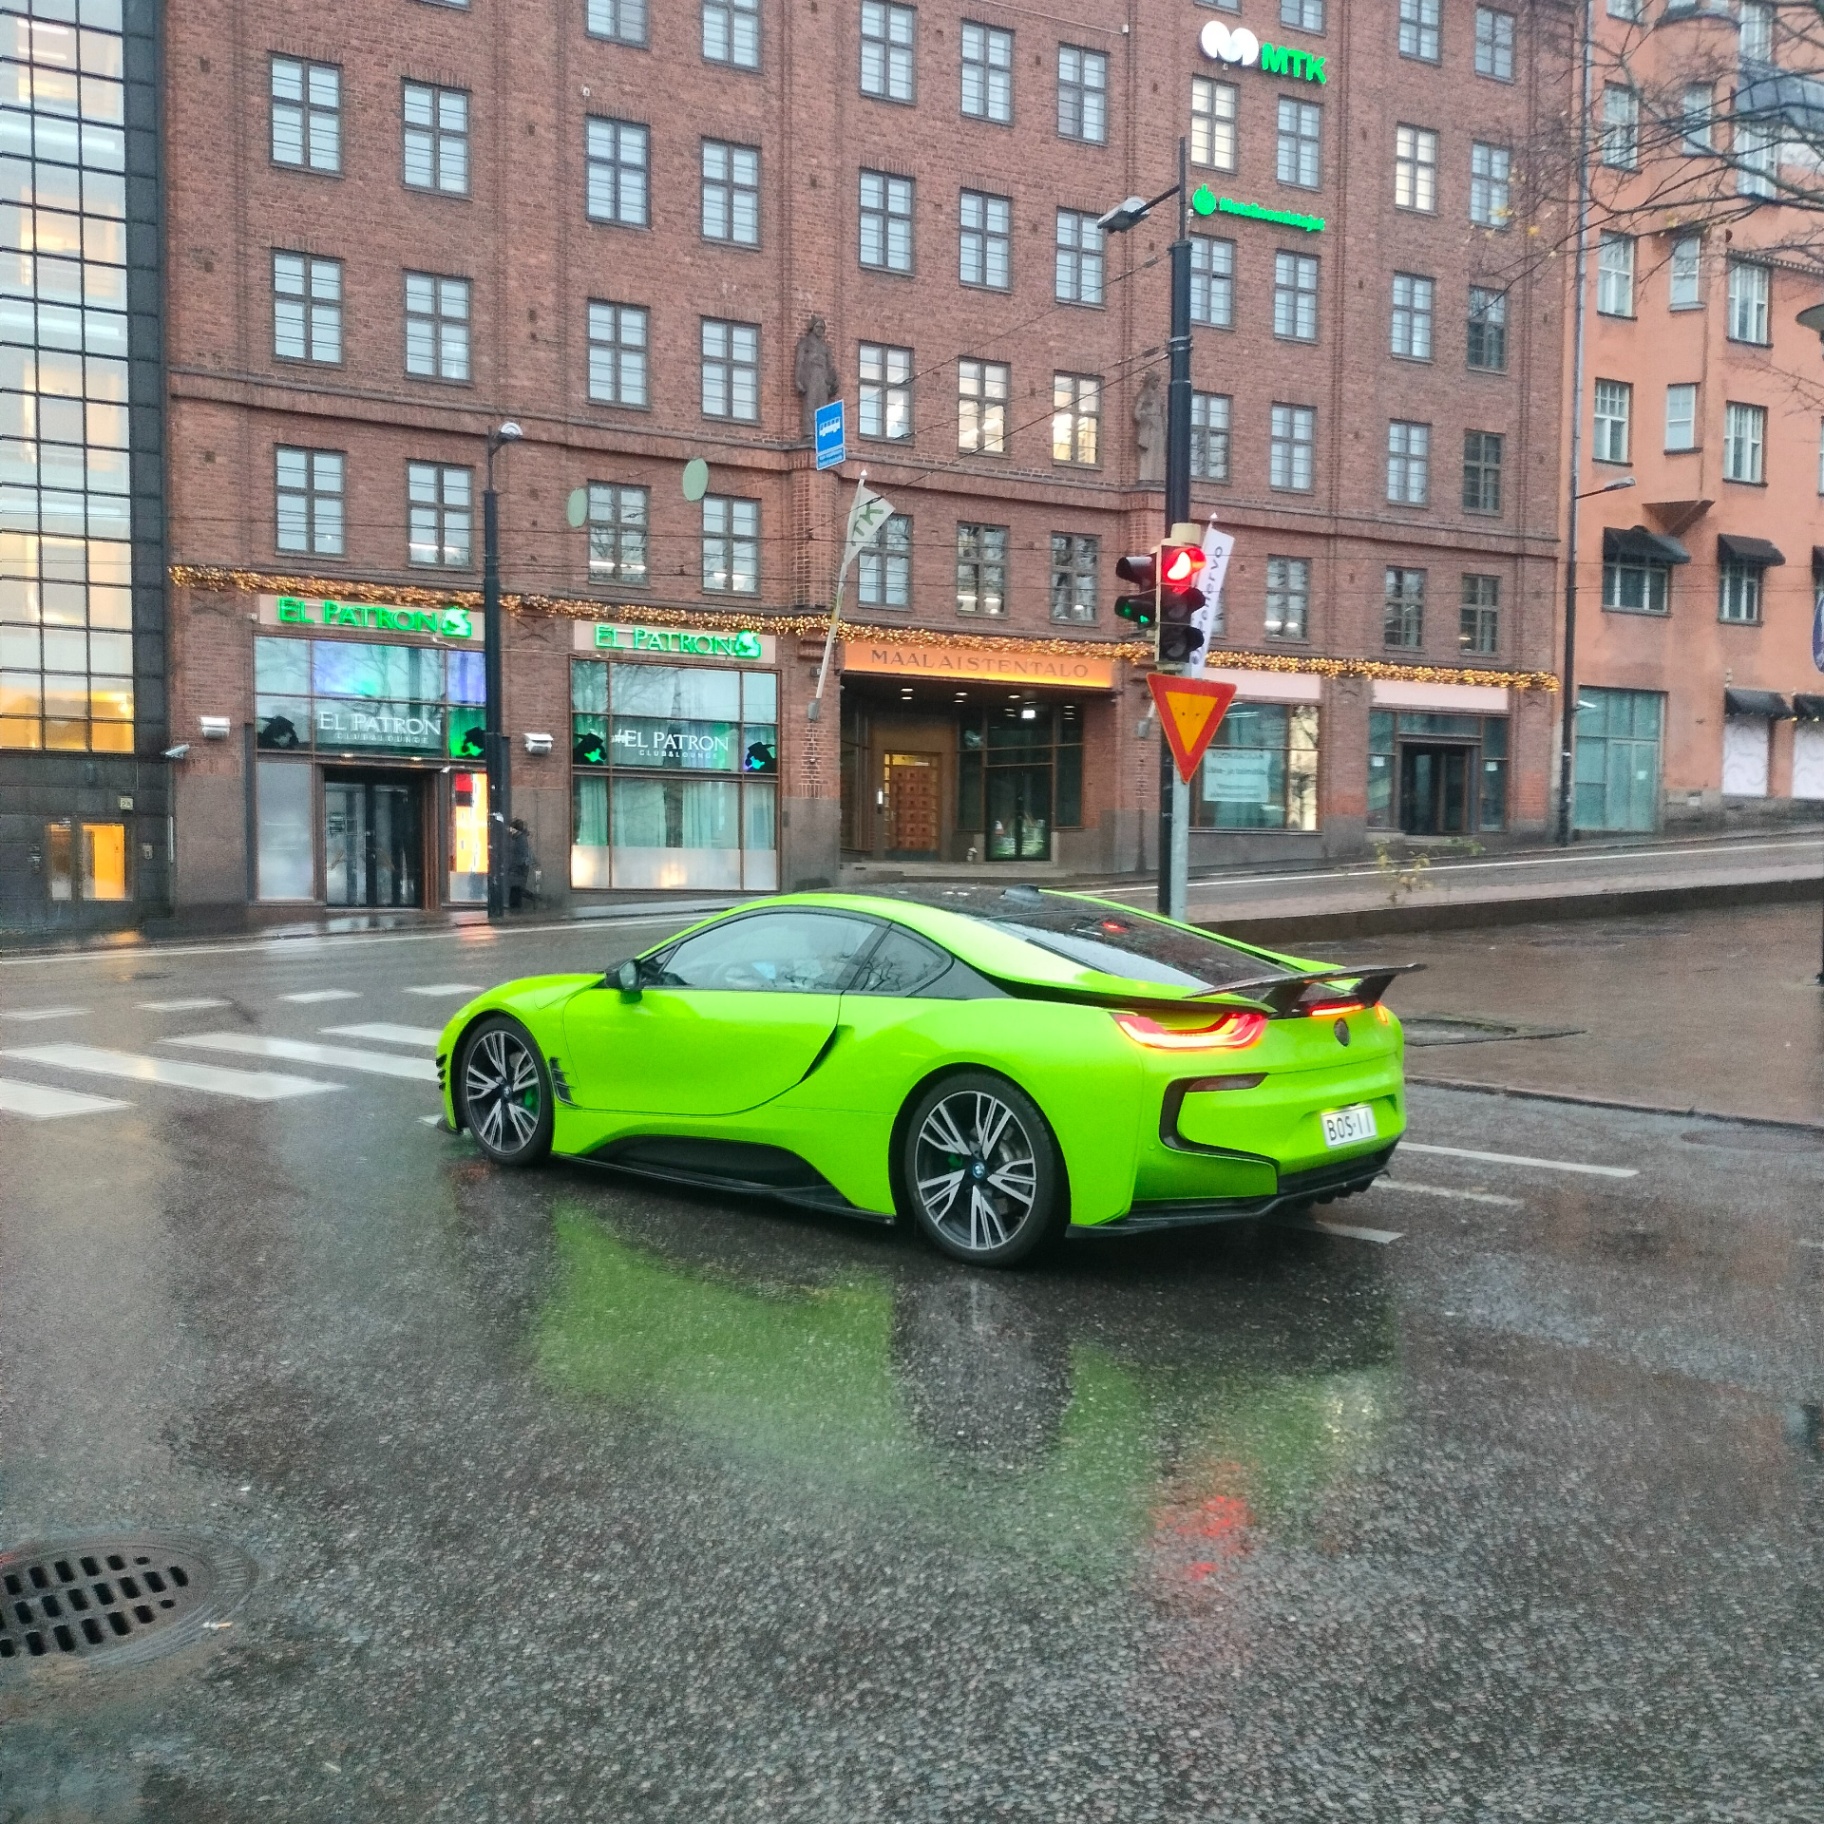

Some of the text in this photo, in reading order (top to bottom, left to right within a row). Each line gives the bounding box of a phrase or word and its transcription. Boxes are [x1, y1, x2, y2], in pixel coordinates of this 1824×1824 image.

[1261, 42, 1326, 84] MTK
[851, 501, 884, 546] TK
[278, 597, 438, 632] EL PATRON
[595, 625, 733, 655] EL PATRON
[871, 649, 1088, 678] MAALAISTENTALO
[319, 712, 441, 735] EL PATRON
[653, 732, 729, 751] PATRON
[1326, 1111, 1371, 1141] BOS-11
